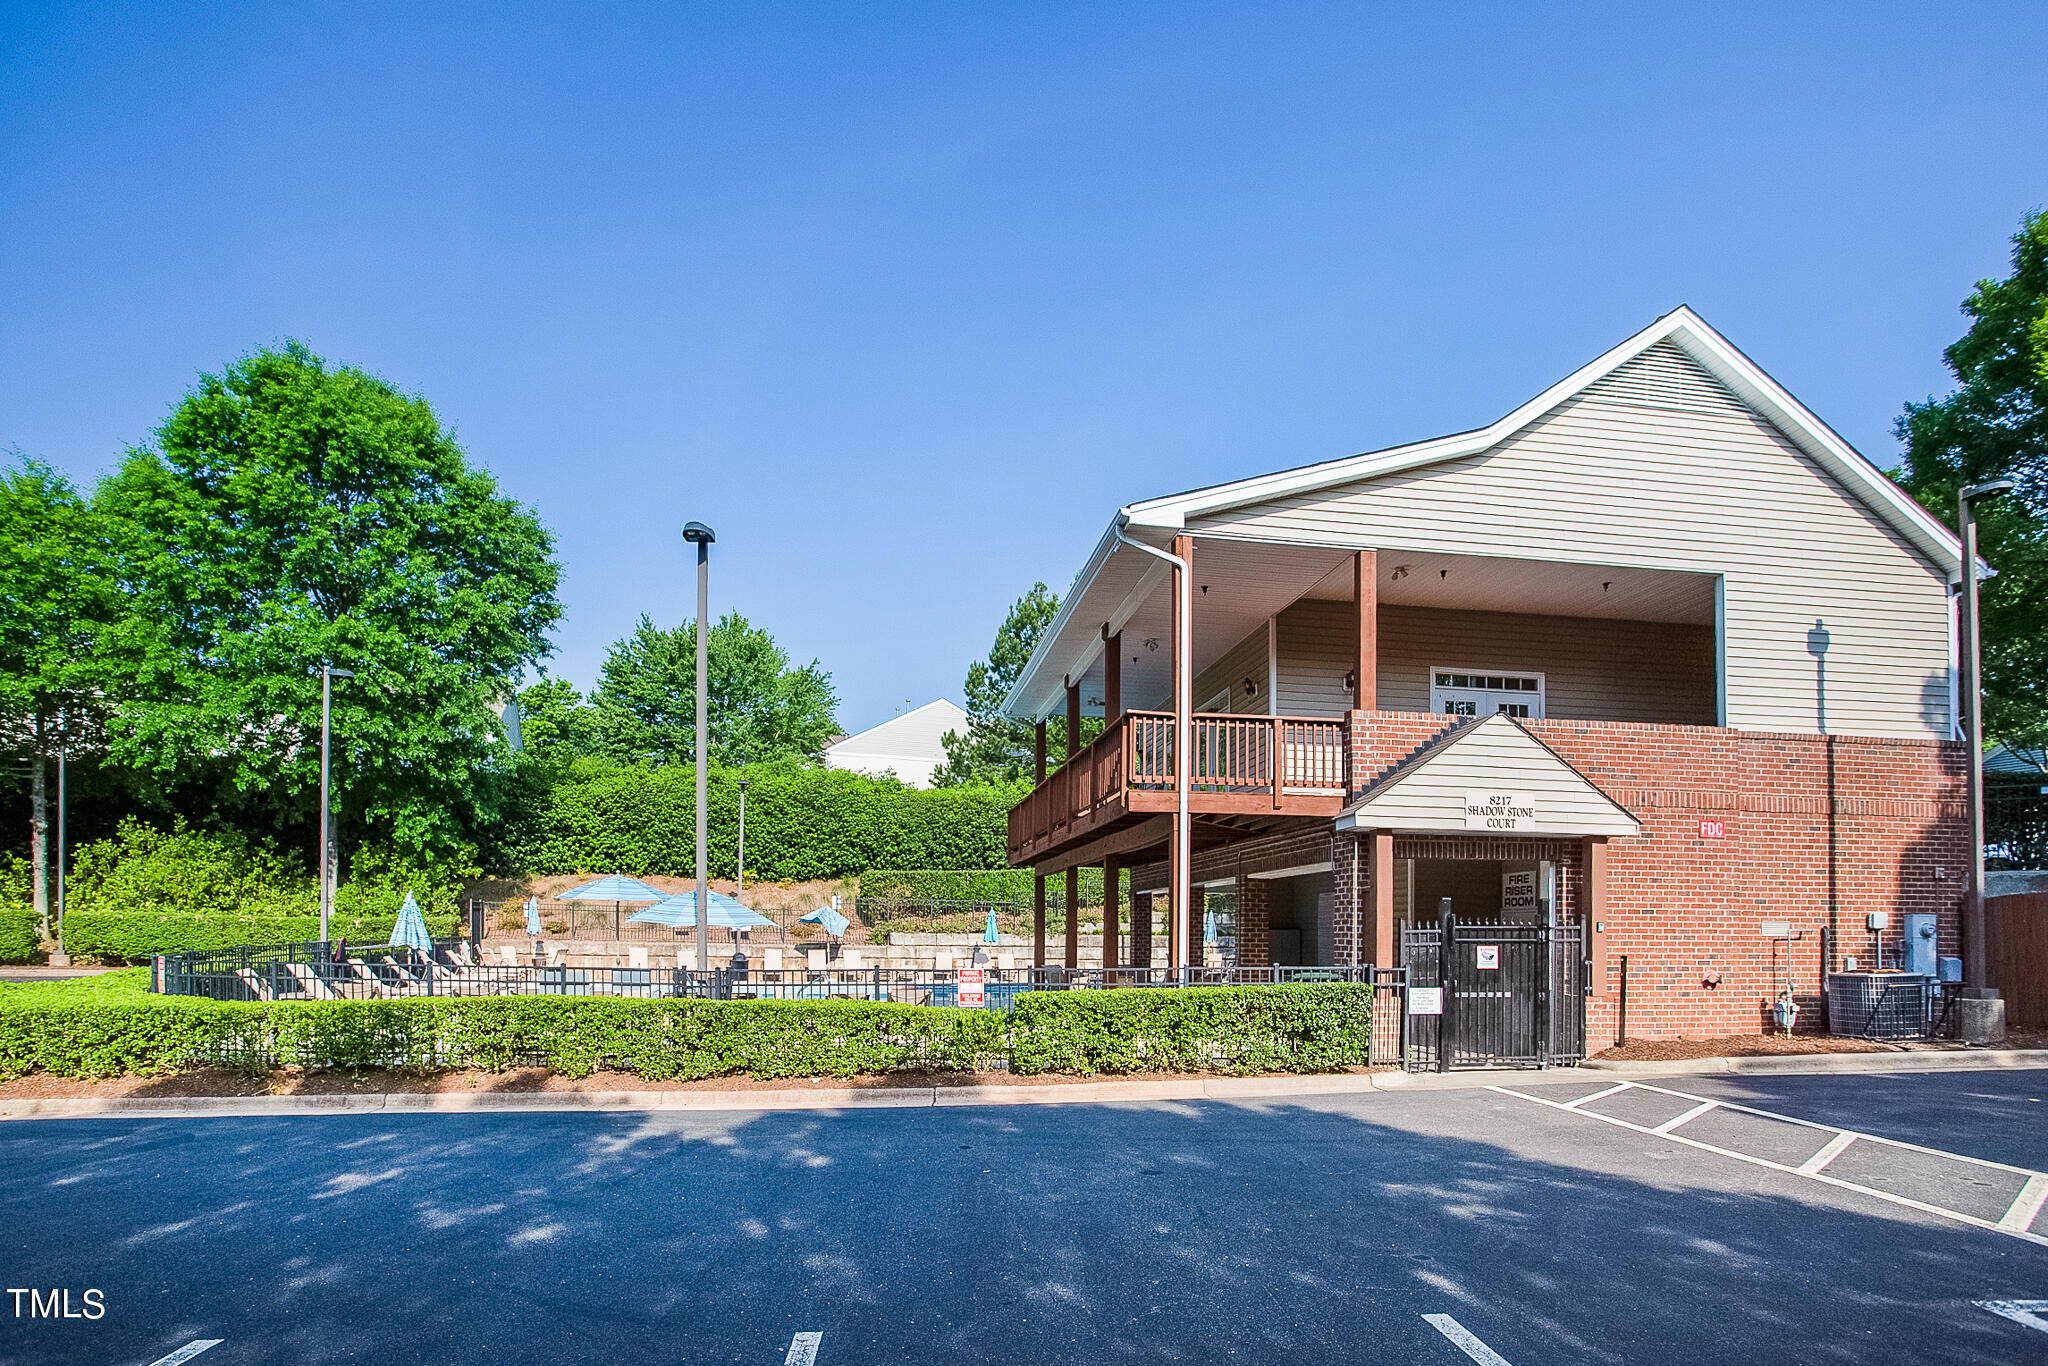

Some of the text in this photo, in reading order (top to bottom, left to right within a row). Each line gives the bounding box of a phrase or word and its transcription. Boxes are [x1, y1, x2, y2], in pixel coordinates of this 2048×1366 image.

[1489, 795, 1512, 805] 8217
[1467, 805, 1534, 818] SHADOW STONE
[1486, 818, 1516, 829] COURT
[1701, 822, 1723, 836] FDC
[1509, 874, 1530, 885] FIRE
[1505, 885, 1533, 896] RISER
[1504, 896, 1534, 907] ROOM
